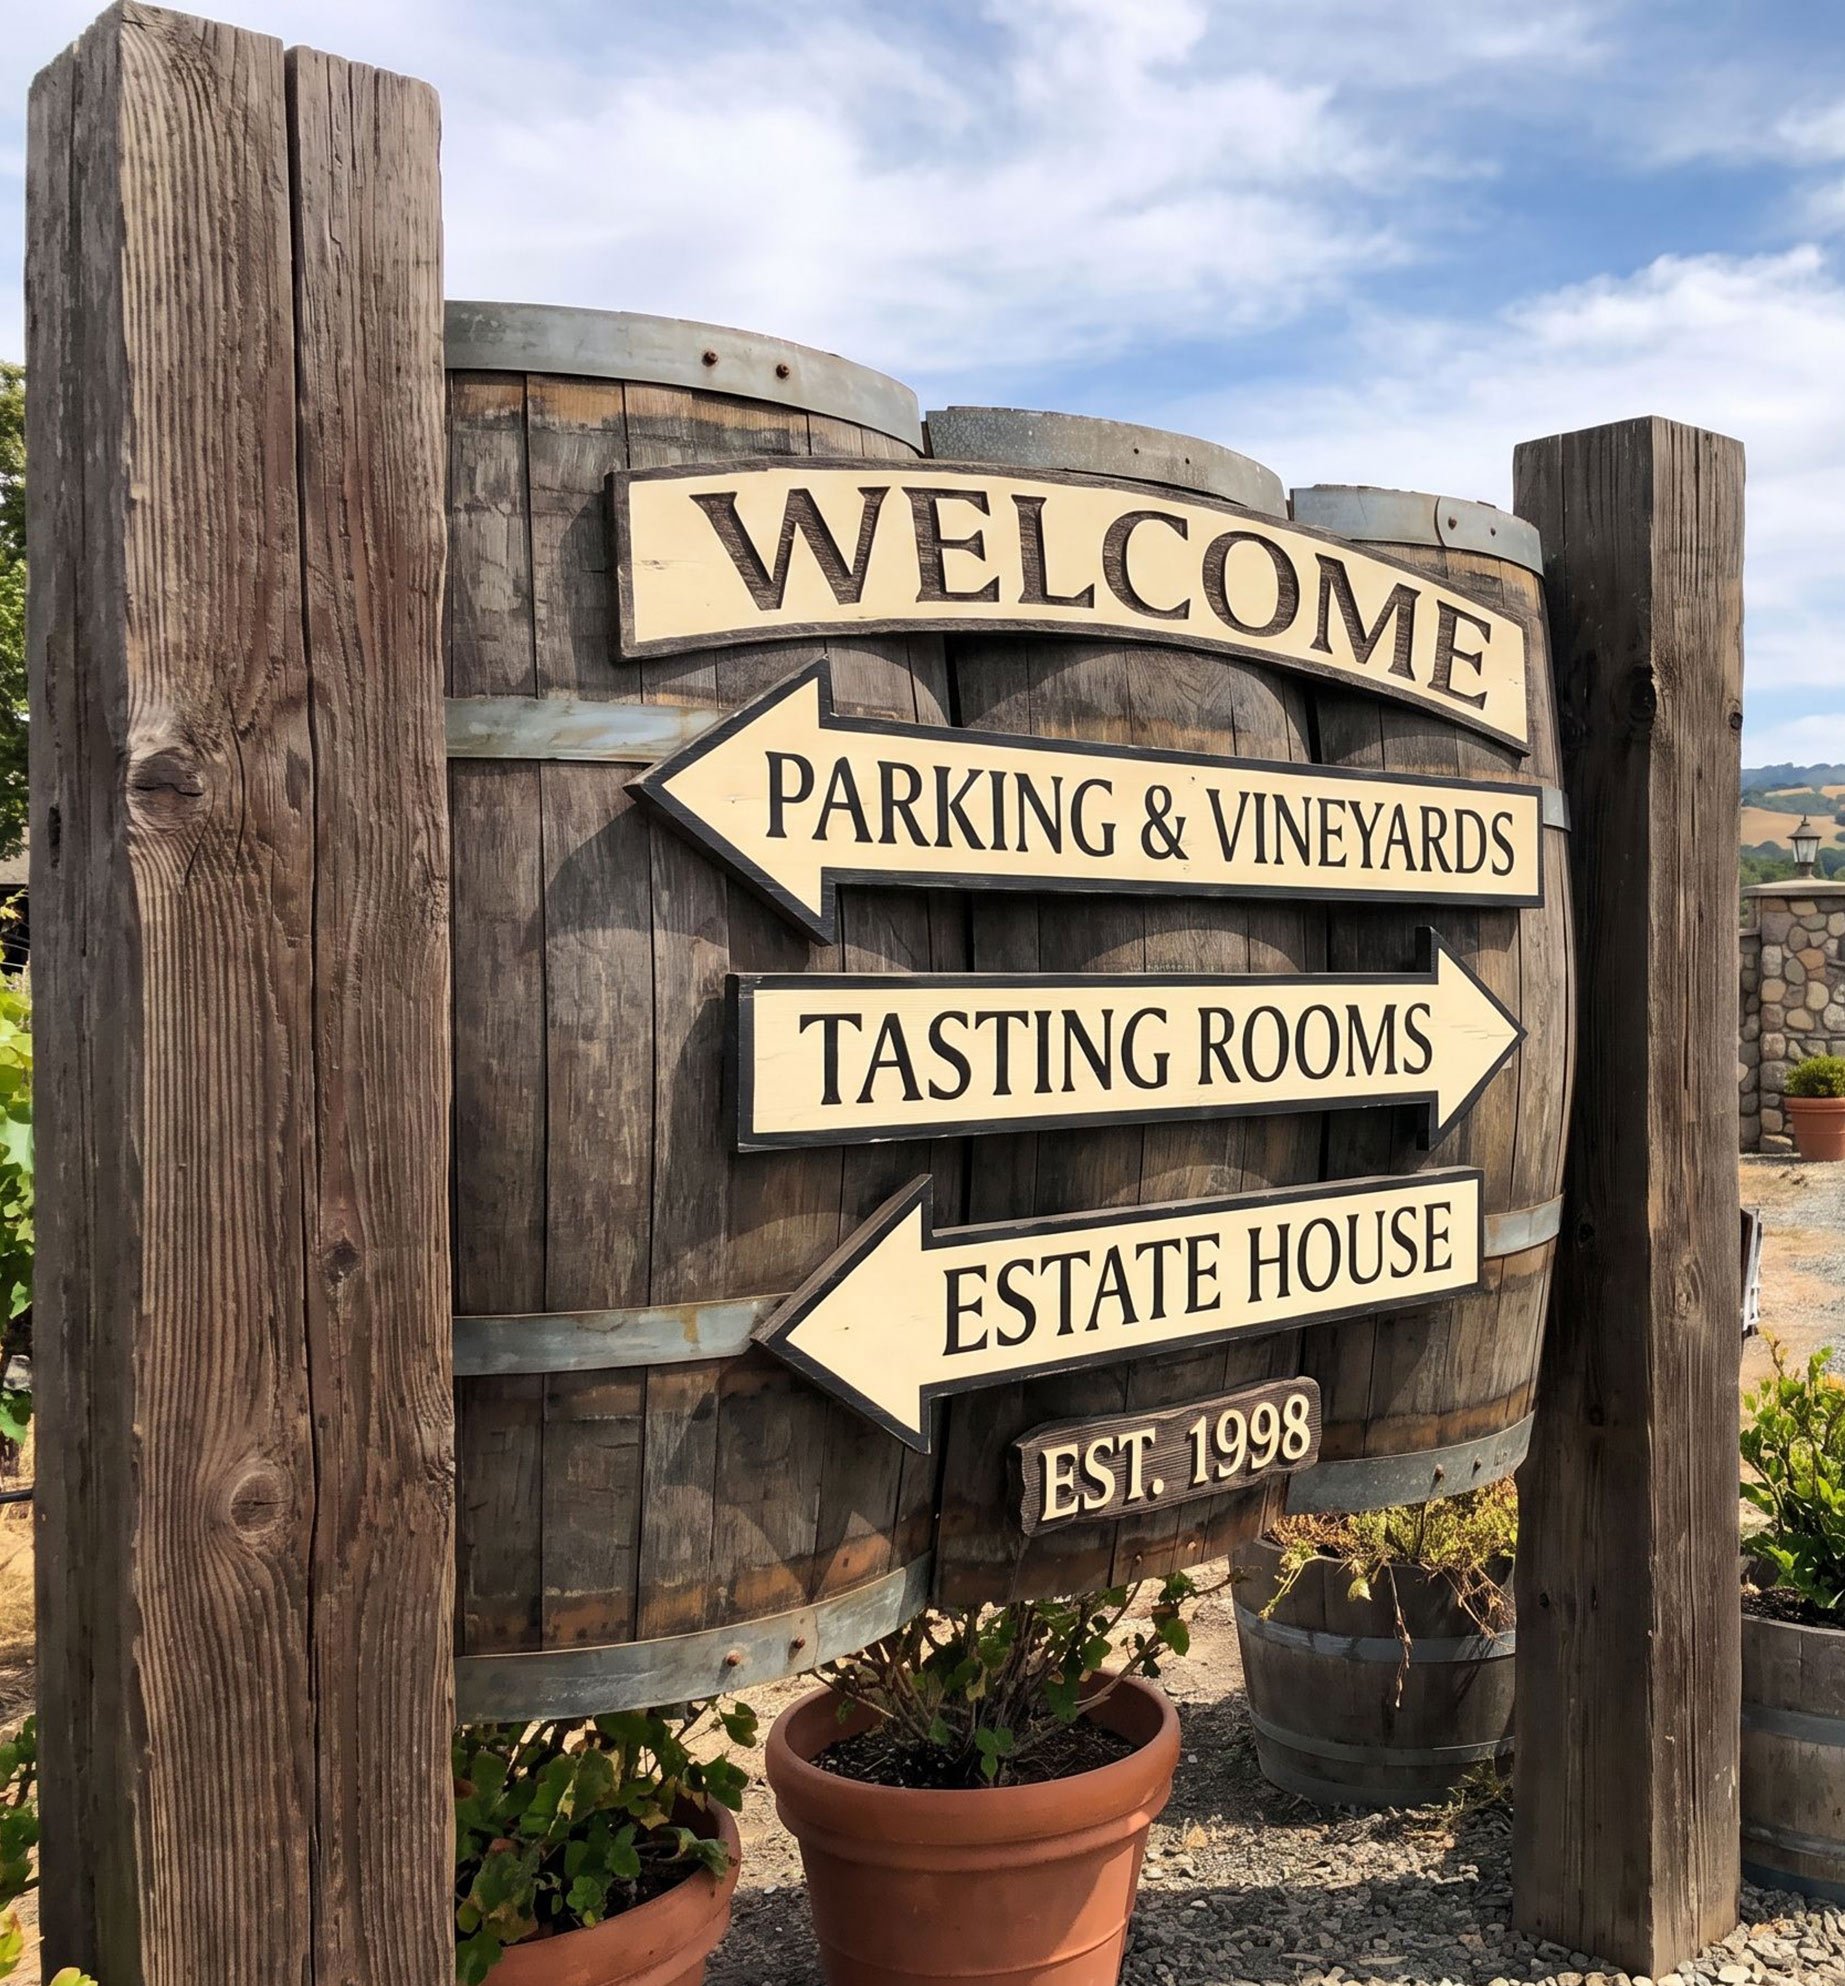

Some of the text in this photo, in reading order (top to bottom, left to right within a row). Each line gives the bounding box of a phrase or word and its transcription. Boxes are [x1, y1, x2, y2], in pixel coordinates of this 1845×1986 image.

[689, 485, 1492, 711] WELCOME
[765, 750, 1515, 877] PARKING & VINEYARDS
[799, 1002, 1433, 1106] TASTING ROOMS
[942, 1201, 1452, 1357] ESTATE HOUSE
[1041, 1393, 1310, 1521] EST. 1998
